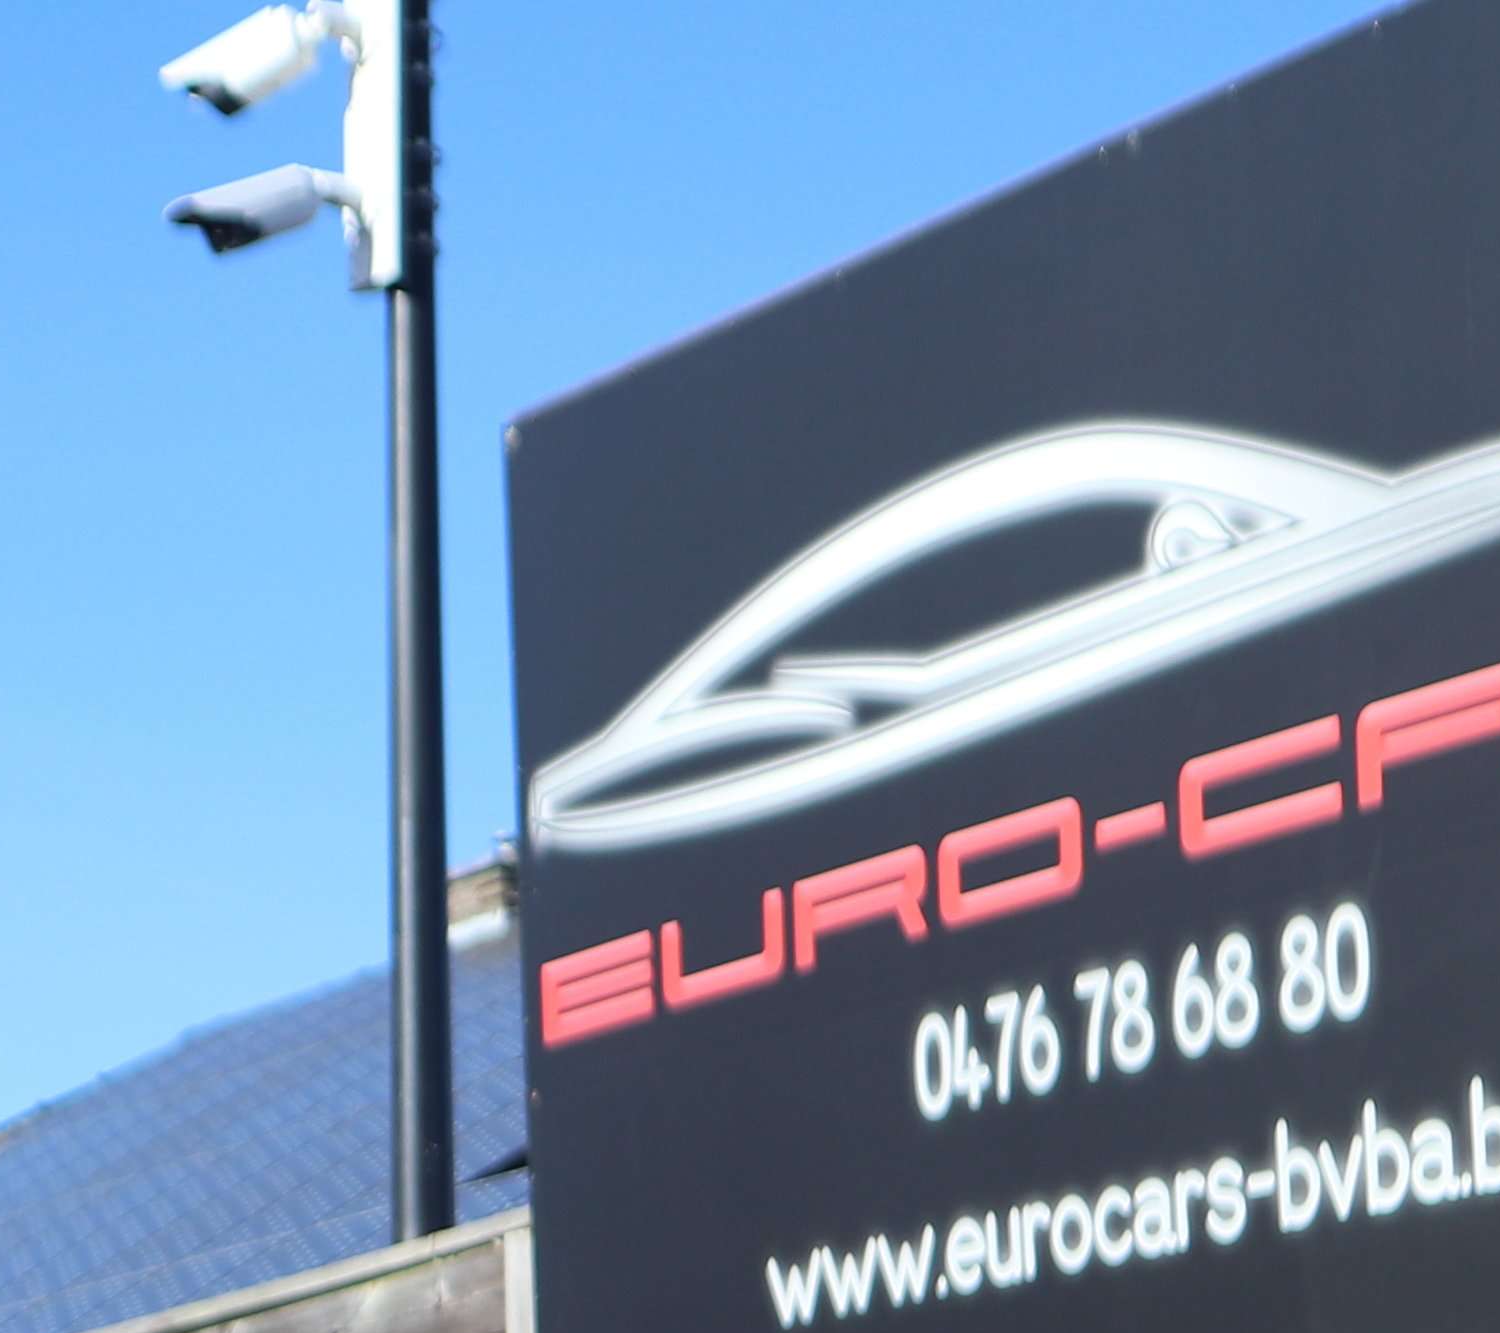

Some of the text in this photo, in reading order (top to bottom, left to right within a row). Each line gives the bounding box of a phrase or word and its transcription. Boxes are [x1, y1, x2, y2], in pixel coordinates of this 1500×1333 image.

[912, 899, 1371, 1121] 0476 78 68 80
